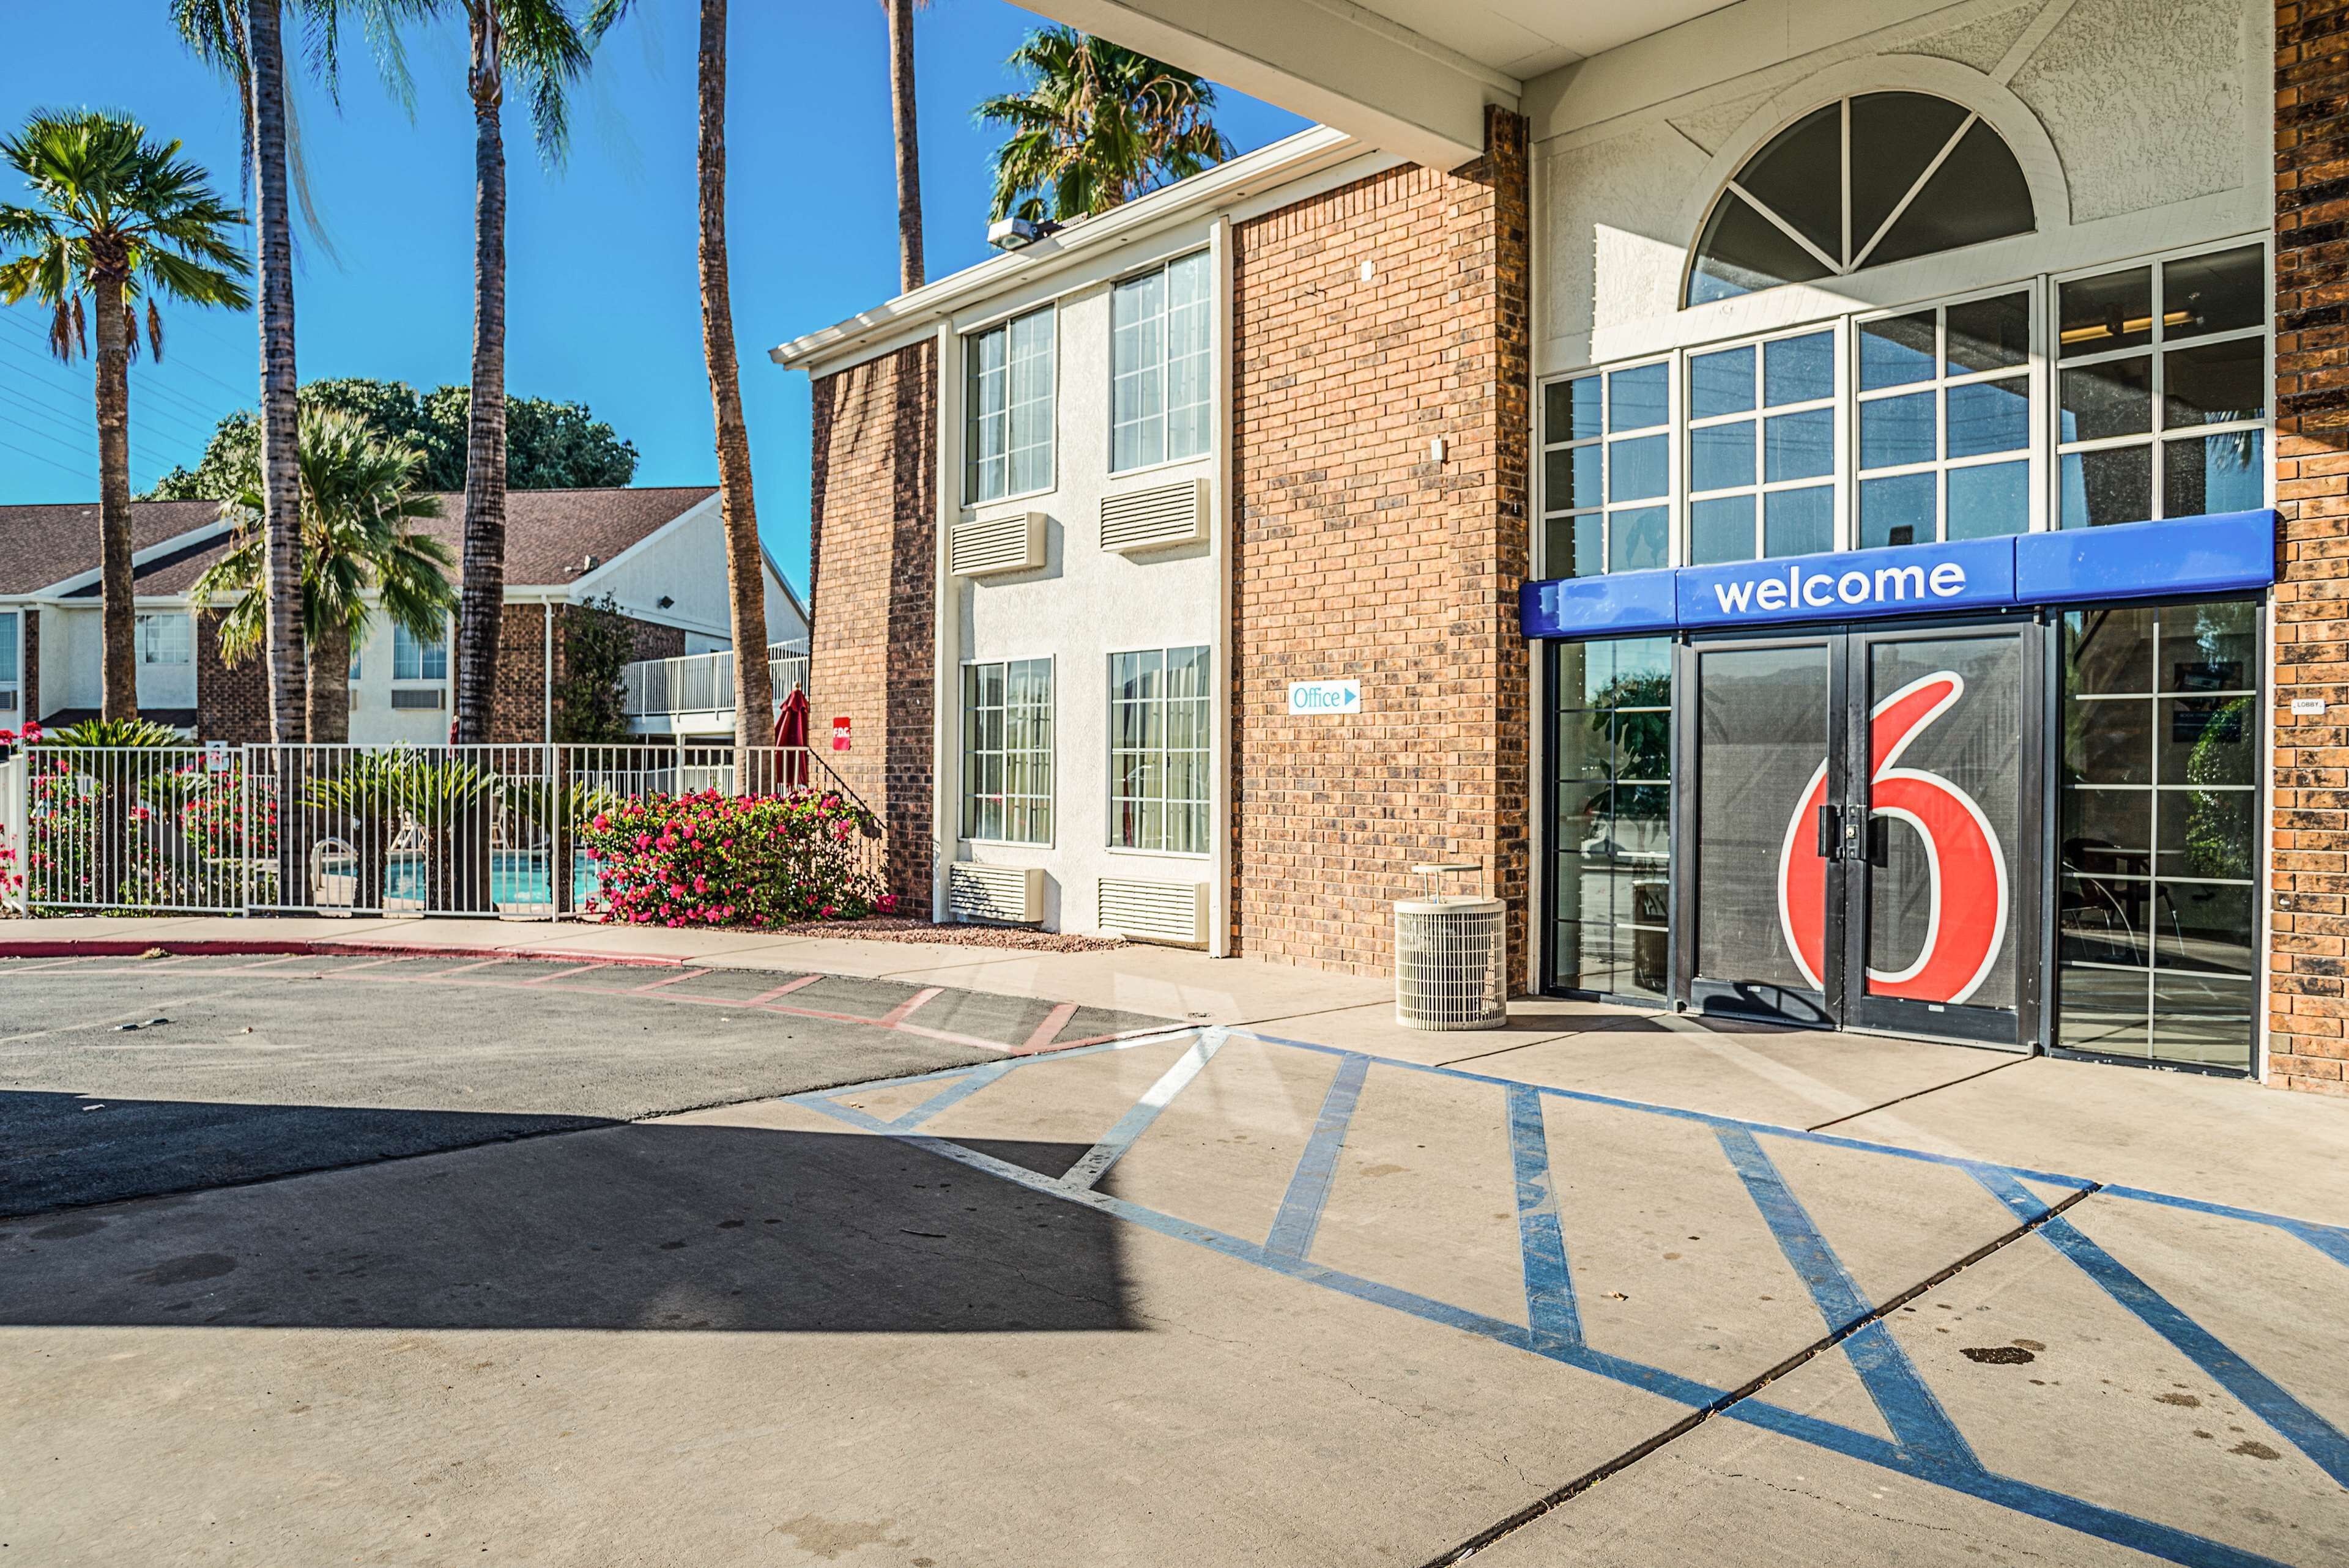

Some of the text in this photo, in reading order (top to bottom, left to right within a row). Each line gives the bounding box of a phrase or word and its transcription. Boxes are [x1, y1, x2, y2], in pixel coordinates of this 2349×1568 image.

[1714, 562, 1966, 613] welcome
[1294, 686, 1340, 708] Office
[1776, 670, 2009, 1005] 6
